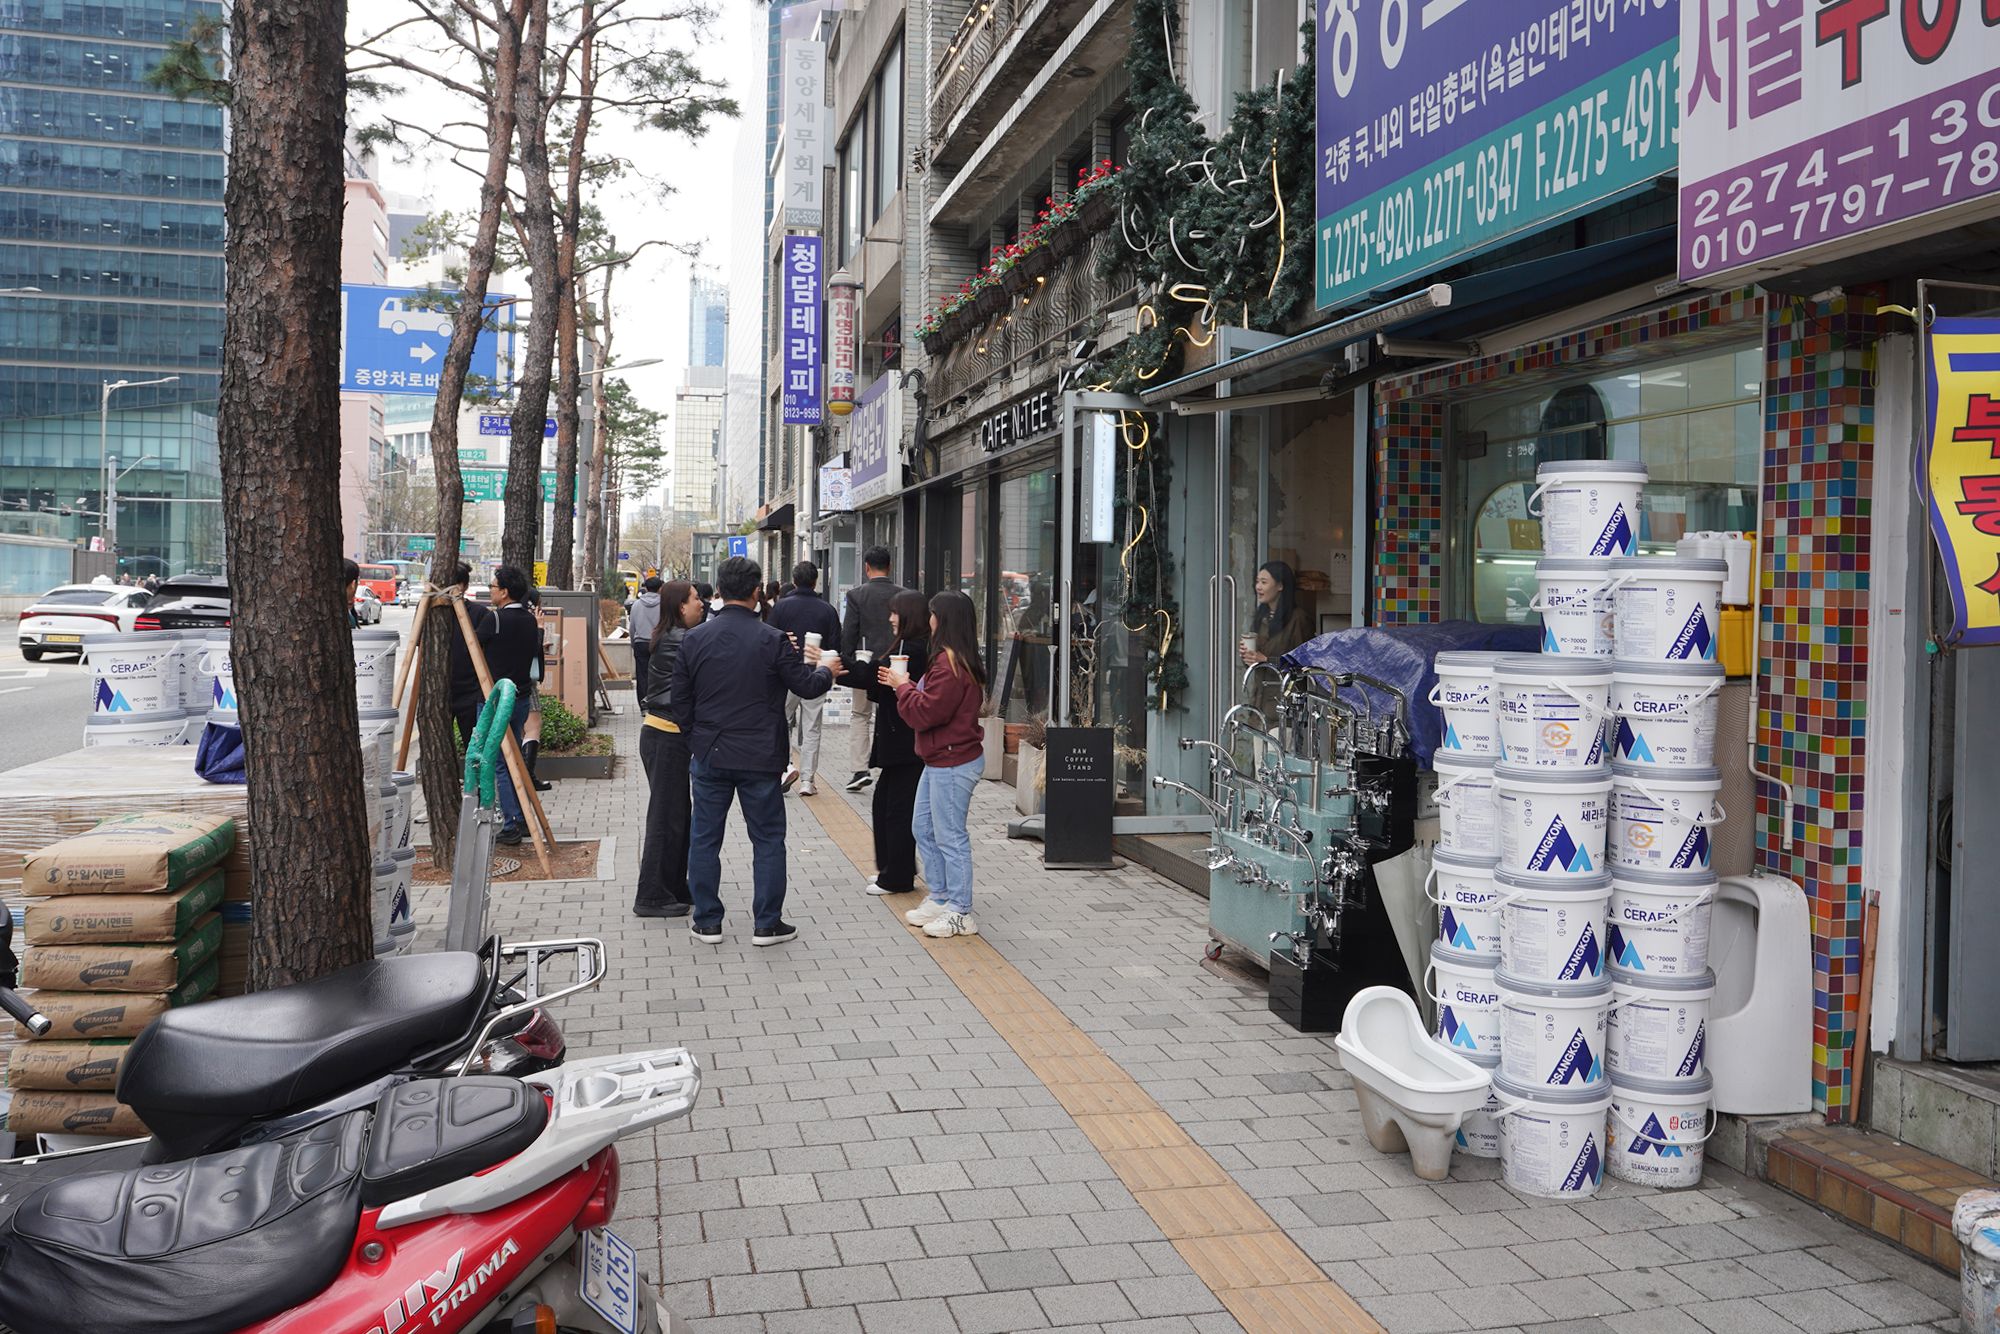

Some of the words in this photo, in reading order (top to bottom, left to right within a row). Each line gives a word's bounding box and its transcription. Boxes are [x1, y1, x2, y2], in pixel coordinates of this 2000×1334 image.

[792, 49, 817, 202] 동양세무회계
[1325, 136, 1350, 185] 각종
[1322, 132, 1523, 290] T.2275-4920.2277-0347
[789, 243, 817, 397] 청담테라피
[354, 368, 439, 388] 중앙차로버
[980, 410, 1008, 452] CAFE
[1593, 506, 1624, 556] SSANGKOM
[1669, 607, 1703, 660] SSANGKOM
[1530, 818, 1563, 872] SSANGKOM
[67, 868, 126, 881] 한일시멘트
[72, 916, 134, 929] 한일시멘트
[1562, 926, 1593, 981] SSANGKOM
[1456, 990, 1499, 1004] CERAFI
[1551, 1031, 1584, 1085] SSANGKOM
[1563, 1136, 1594, 1192] SSANGKOM
[428, 1237, 520, 1328] PRIMA
[606, 1235, 630, 1304] 6757
